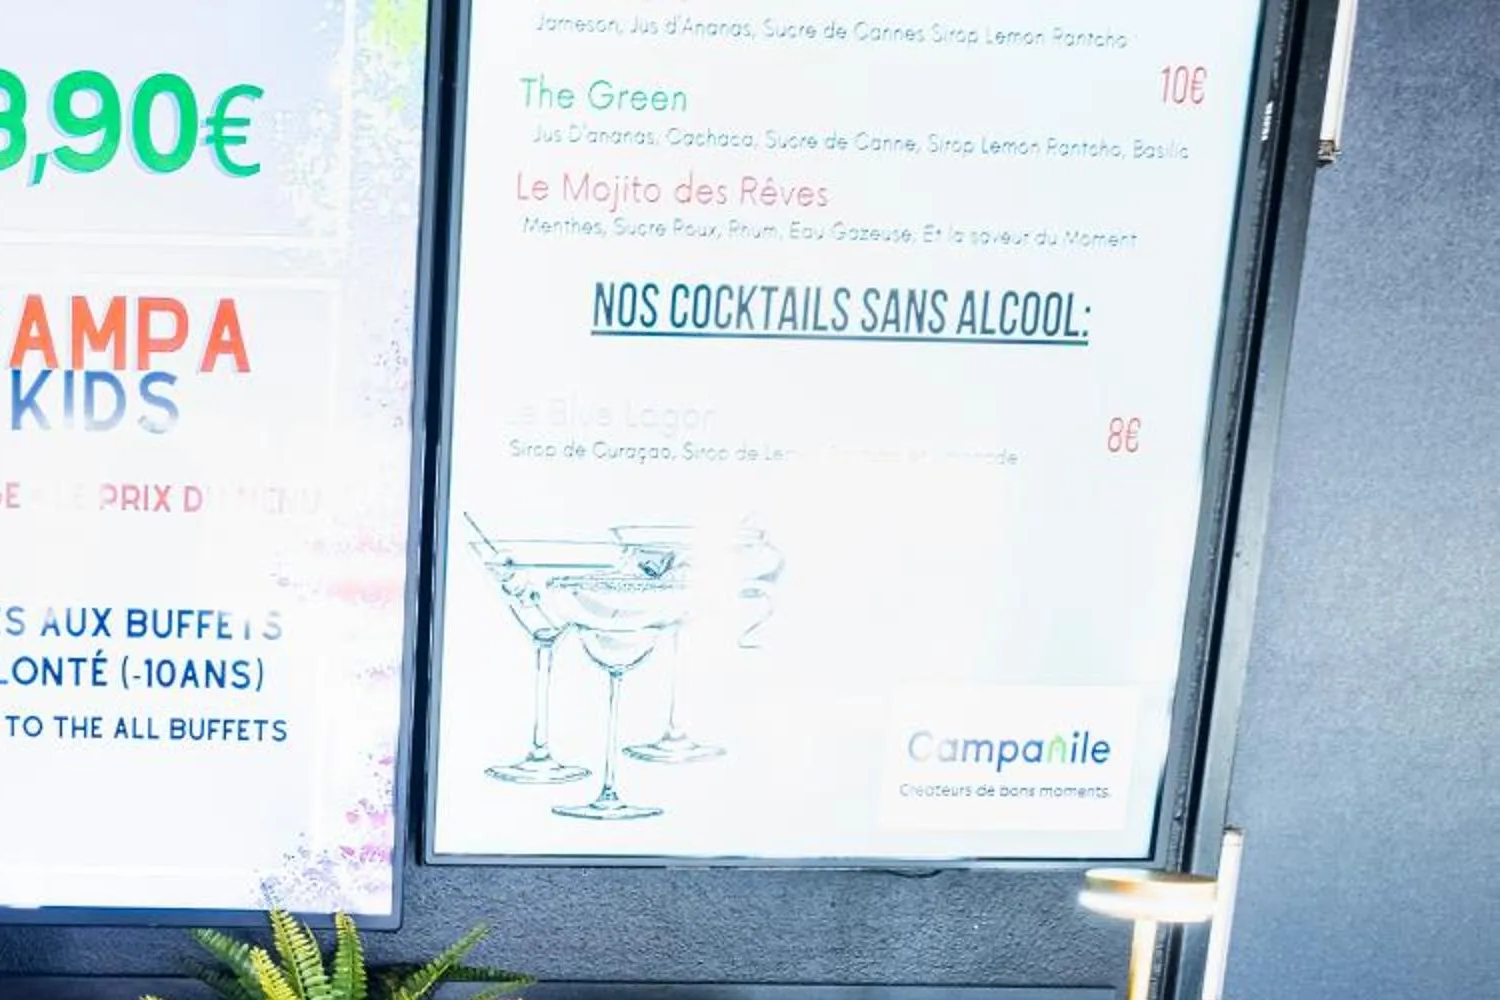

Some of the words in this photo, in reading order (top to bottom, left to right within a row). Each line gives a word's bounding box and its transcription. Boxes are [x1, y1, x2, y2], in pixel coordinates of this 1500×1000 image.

[630, 16, 658, 34] Jus
[763, 18, 817, 39] Sucre
[824, 20, 847, 39] de
[931, 23, 979, 46] Sirop
[986, 26, 1044, 46] Lemon
[520, 73, 575, 109] The
[587, 79, 687, 112] Green
[1160, 65, 1207, 105] 10€
[533, 125, 562, 144] Jus
[765, 130, 818, 150] Sucre
[825, 131, 848, 150] de
[928, 133, 975, 156] Sirop
[981, 137, 1040, 156] Lemon
[517, 171, 549, 201] Le
[562, 173, 662, 213] Mojito
[674, 171, 728, 206] des
[740, 176, 829, 207] Rêves
[613, 217, 666, 238] Sucre
[1035, 227, 1057, 246] du
[592, 282, 660, 328] NOS
[670, 283, 851, 332] COCKTAILS
[861, 288, 948, 334] SANS
[956, 289, 1091, 338] ALCOOL:
[11, 369, 180, 435] KIDS
[564, 439, 586, 458] de
[736, 443, 759, 462] de
[1107, 417, 1142, 453] 8€
[99, 484, 172, 513] PRIX
[40, 607, 112, 638] AUX
[121, 656, 265, 692] (-10ANS)
[5, 715, 43, 738] TO
[54, 716, 103, 739] THE
[113, 717, 160, 740] ALL
[170, 719, 288, 742] BUFFETS
[908, 730, 1111, 773] Campanile
[976, 783, 995, 798] de
